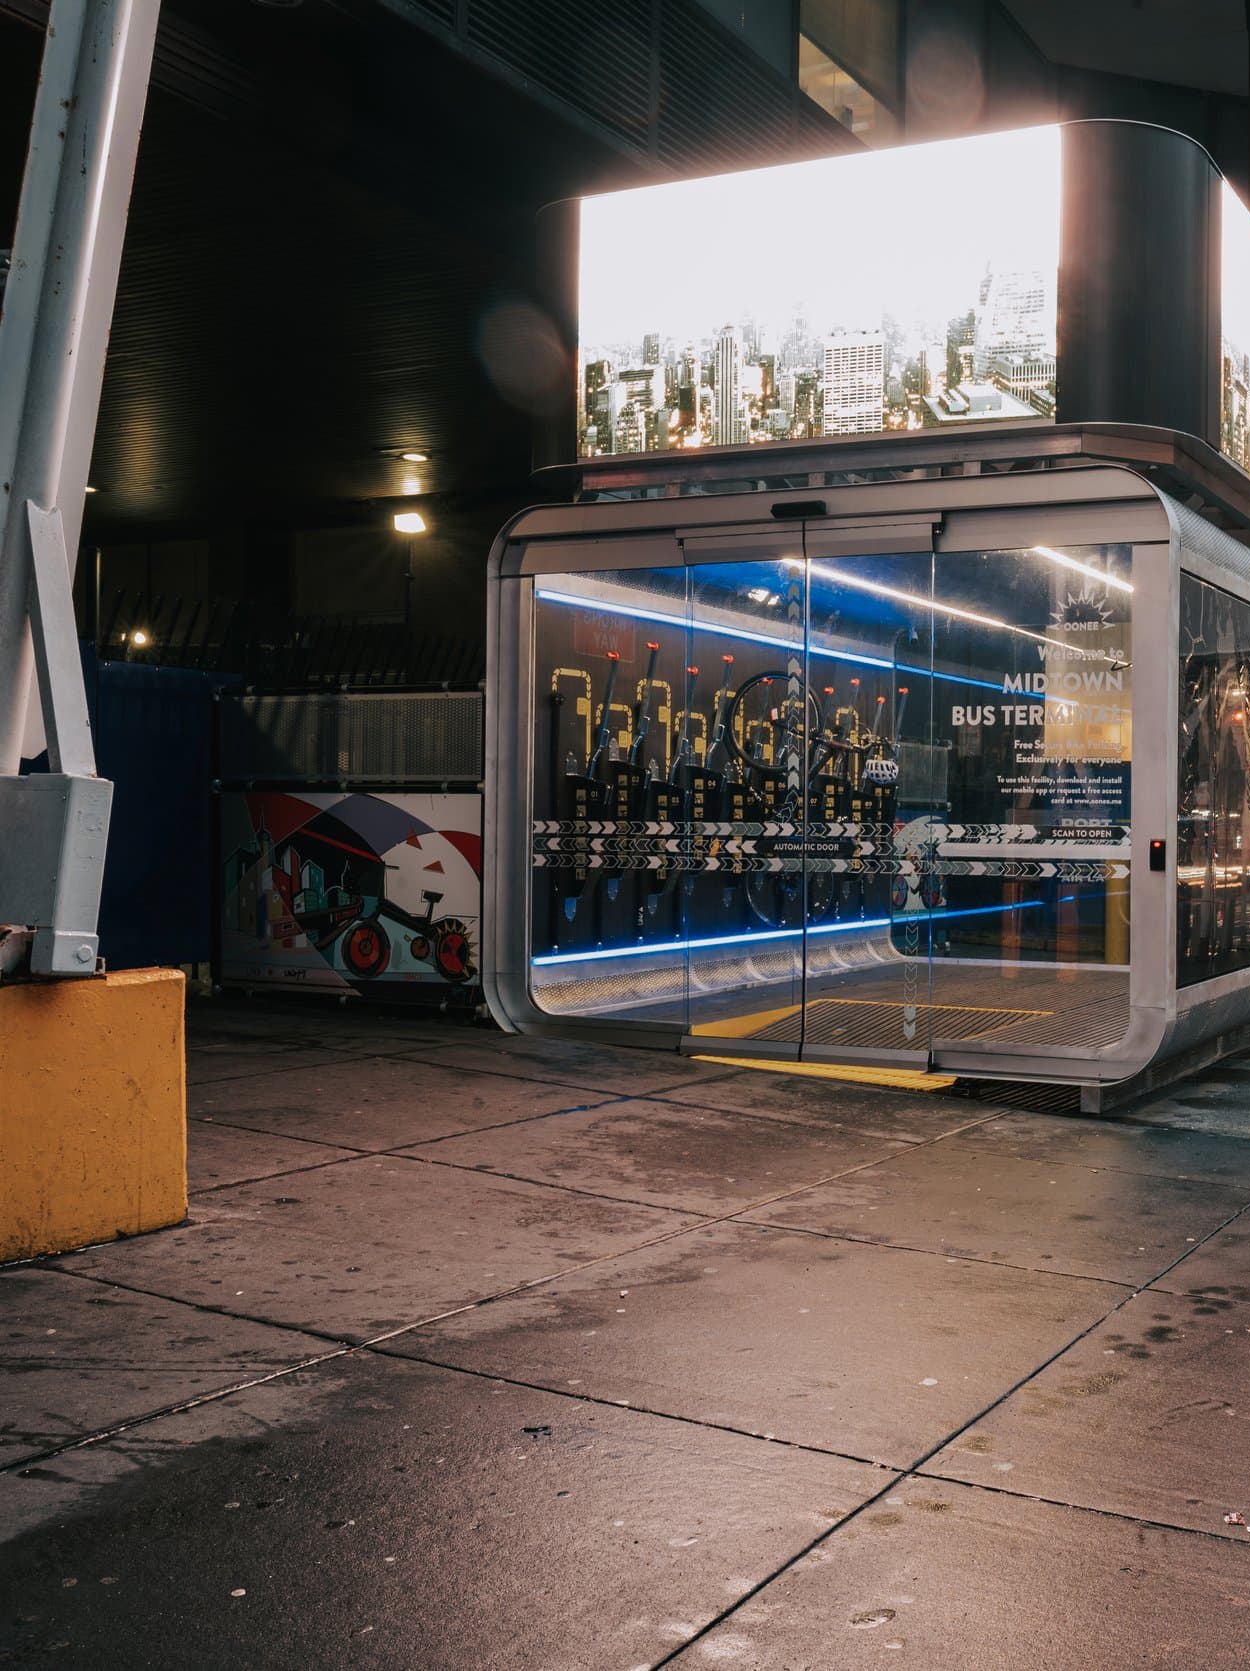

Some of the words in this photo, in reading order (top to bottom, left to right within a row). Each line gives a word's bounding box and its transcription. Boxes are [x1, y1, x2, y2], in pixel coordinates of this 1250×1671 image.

[1063, 621, 1099, 632] OONEE
[1037, 645, 1106, 661] Welcome
[1109, 647, 1125, 660] to
[1002, 671, 1123, 694] MIDTOWN
[951, 705, 996, 726] BUS
[1013, 739, 1033, 750] Free
[1015, 753, 1063, 767] Exclusively
[1065, 754, 1079, 763] for
[1080, 757, 1122, 767] everyone
[996, 775, 1005, 783] To
[1017, 775, 1030, 783] this
[1030, 775, 1056, 786] facility,
[1056, 775, 1087, 784] download
[1088, 775, 1101, 784] and
[1101, 776, 1123, 784] install
[1012, 785, 1035, 794] mobile
[1035, 788, 1048, 796] app
[1056, 787, 1081, 796] request
[1087, 785, 1101, 794] free
[1050, 796, 1065, 804] card
[1051, 830, 1075, 838] SCAN
[1075, 830, 1087, 838] TO
[1088, 830, 1112, 838] OPEN
[816, 843, 839, 851] DOOR
